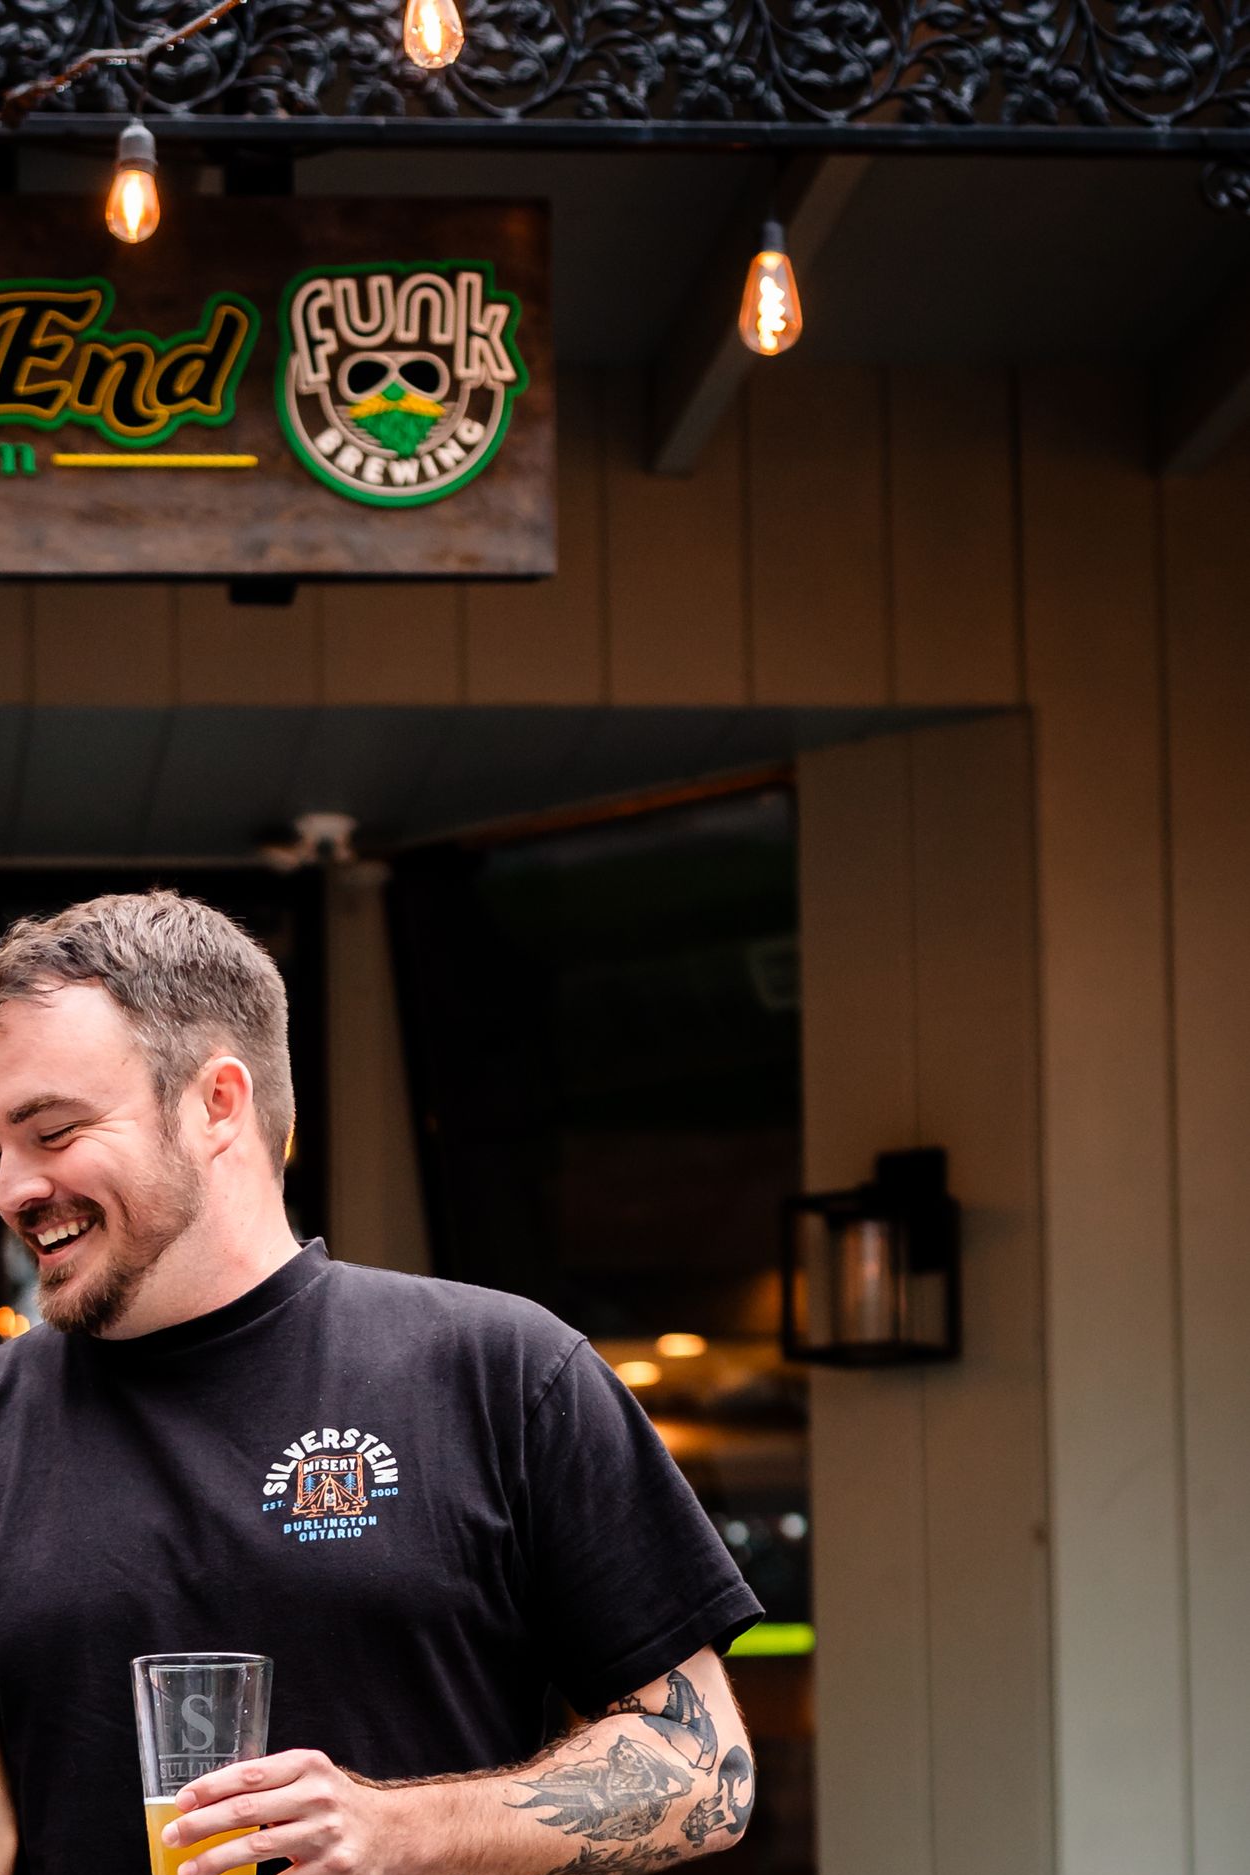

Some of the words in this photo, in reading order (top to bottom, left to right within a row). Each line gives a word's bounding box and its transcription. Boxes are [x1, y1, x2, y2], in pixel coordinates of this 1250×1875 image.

[312, 417, 487, 487] BREWING
[262, 1427, 400, 1497] SILVERSTEIN
[302, 1457, 358, 1476] MISERY
[262, 1499, 287, 1513] EST.
[370, 1487, 399, 1498] 2000
[282, 1515, 378, 1535] BURLINGTON
[298, 1526, 363, 1543] ONTARIO
[181, 1693, 216, 1752] S
[159, 1761, 230, 1779] SULLIV
